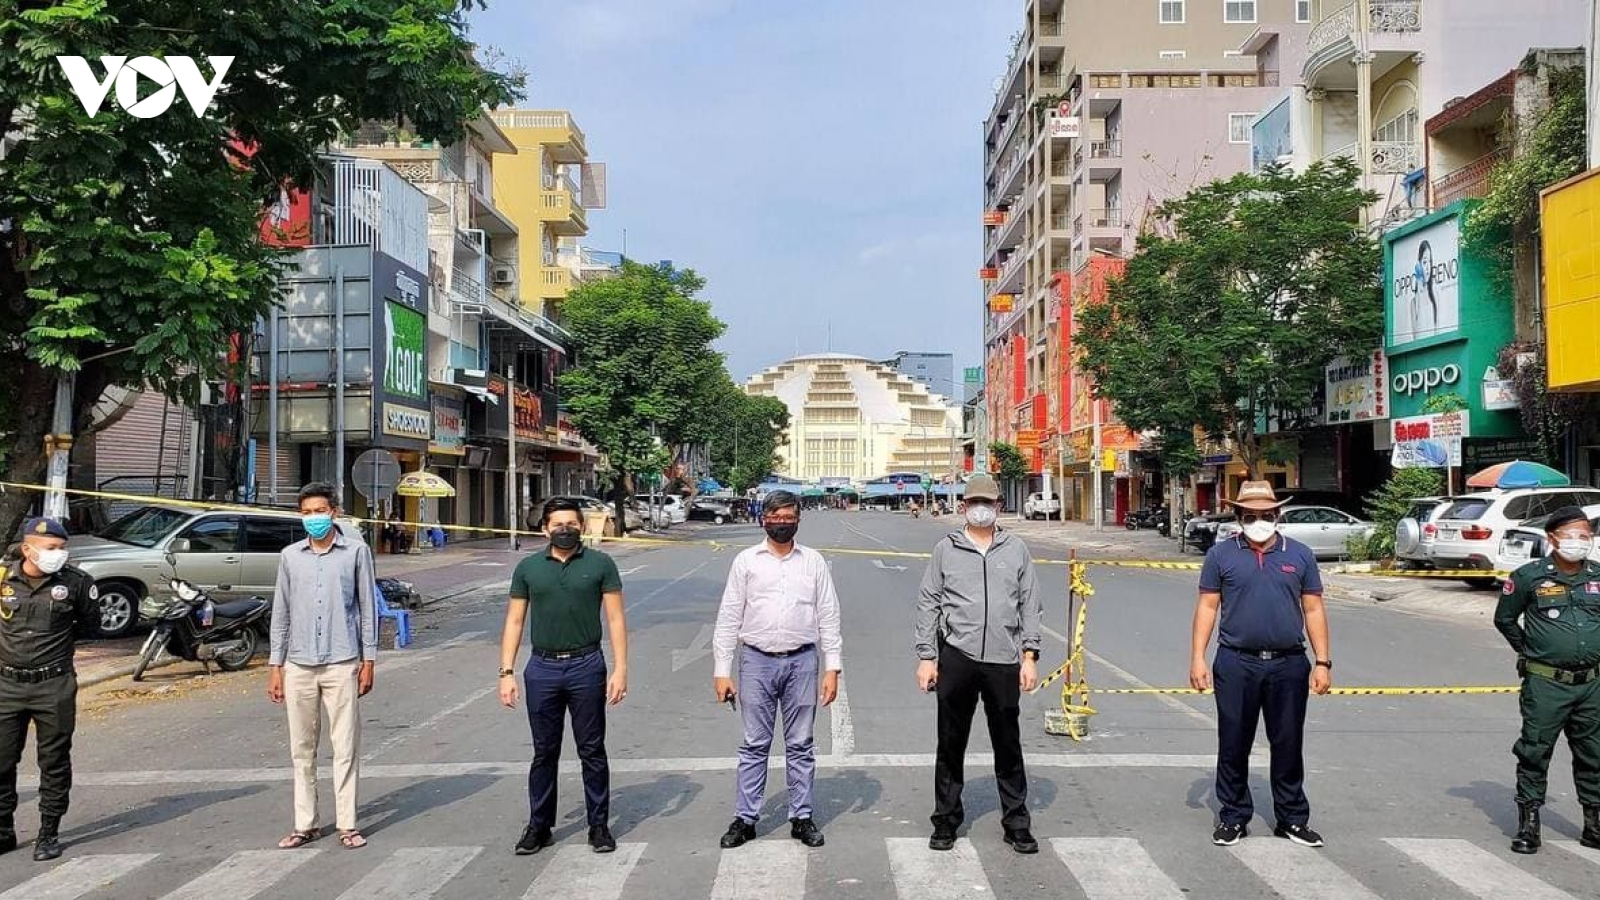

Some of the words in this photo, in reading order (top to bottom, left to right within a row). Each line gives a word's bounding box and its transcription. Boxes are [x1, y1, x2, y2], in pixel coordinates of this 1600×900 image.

[1395, 273, 1418, 298] OPPO
[1431, 259, 1458, 284] RENO
[396, 346, 423, 396] GOLF
[1393, 364, 1459, 397] oppo
